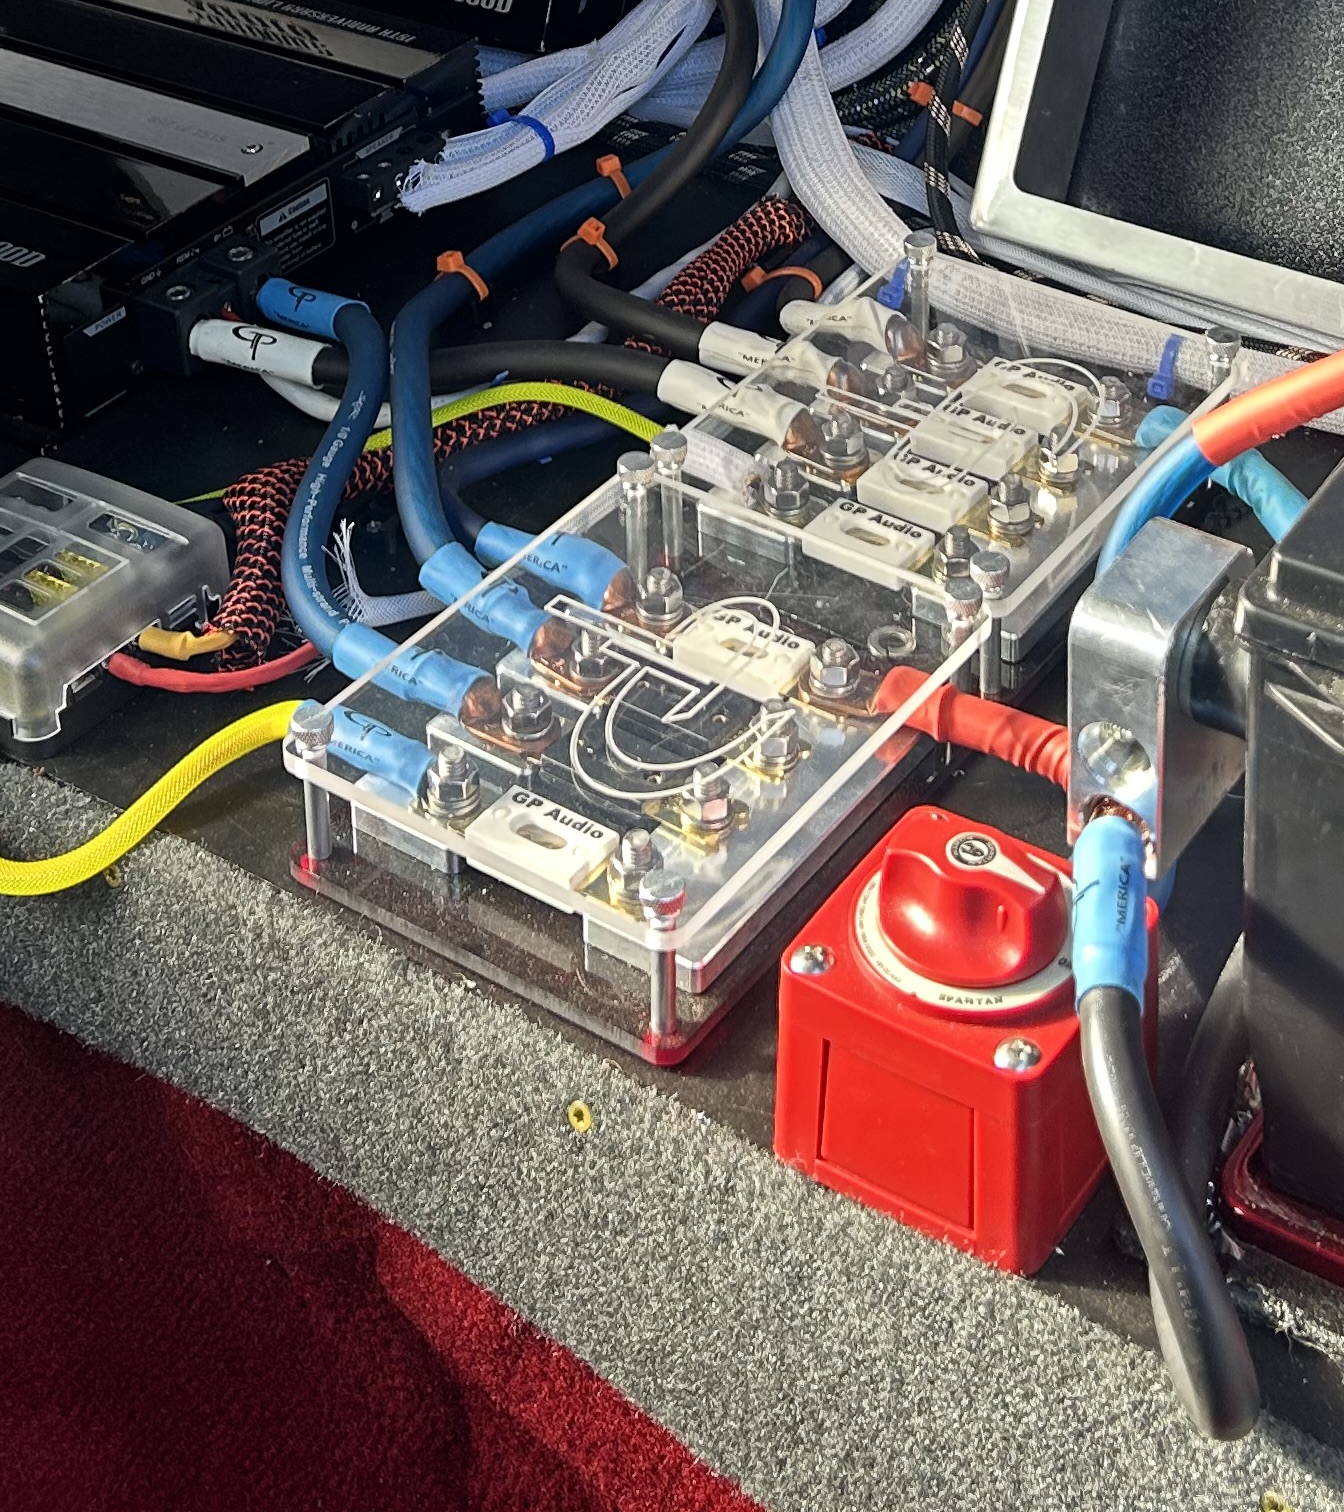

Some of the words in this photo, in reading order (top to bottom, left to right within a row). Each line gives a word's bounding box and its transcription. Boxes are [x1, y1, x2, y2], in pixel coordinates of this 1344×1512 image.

[839, 500, 868, 516] GP
[868, 514, 923, 539] Audio
[513, 791, 543, 809] GP
[543, 805, 605, 840] Audio
